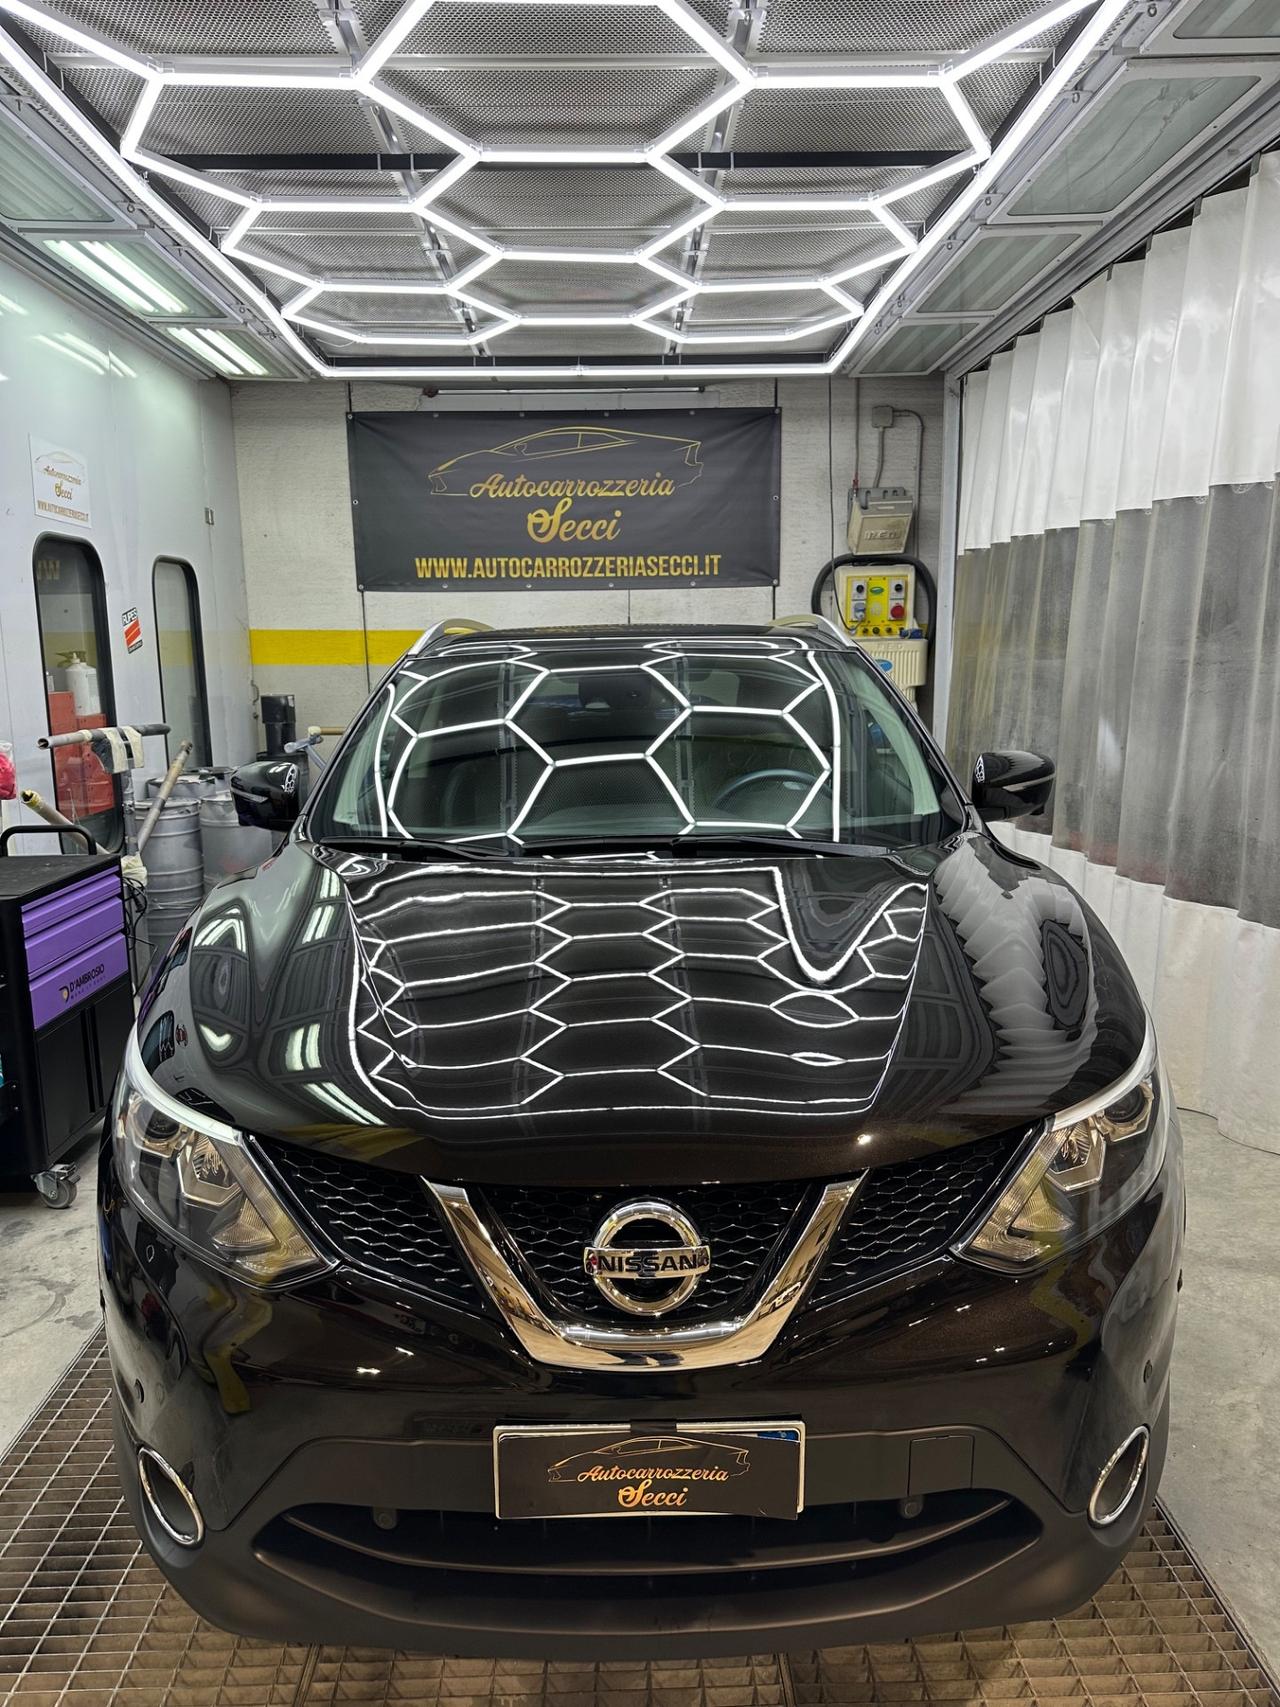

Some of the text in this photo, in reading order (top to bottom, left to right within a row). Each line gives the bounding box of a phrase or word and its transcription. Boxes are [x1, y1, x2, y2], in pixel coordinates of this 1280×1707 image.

[470, 473, 675, 498] Autocarrozzeria
[527, 497, 622, 543] Secci
[416, 555, 721, 577] WWW.AUTOCARROZZERIASECCI.IT
[600, 1254, 697, 1273] NISSAN
[577, 1466, 729, 1482] Autocarrozzeria
[617, 1479, 689, 1508] Secci
